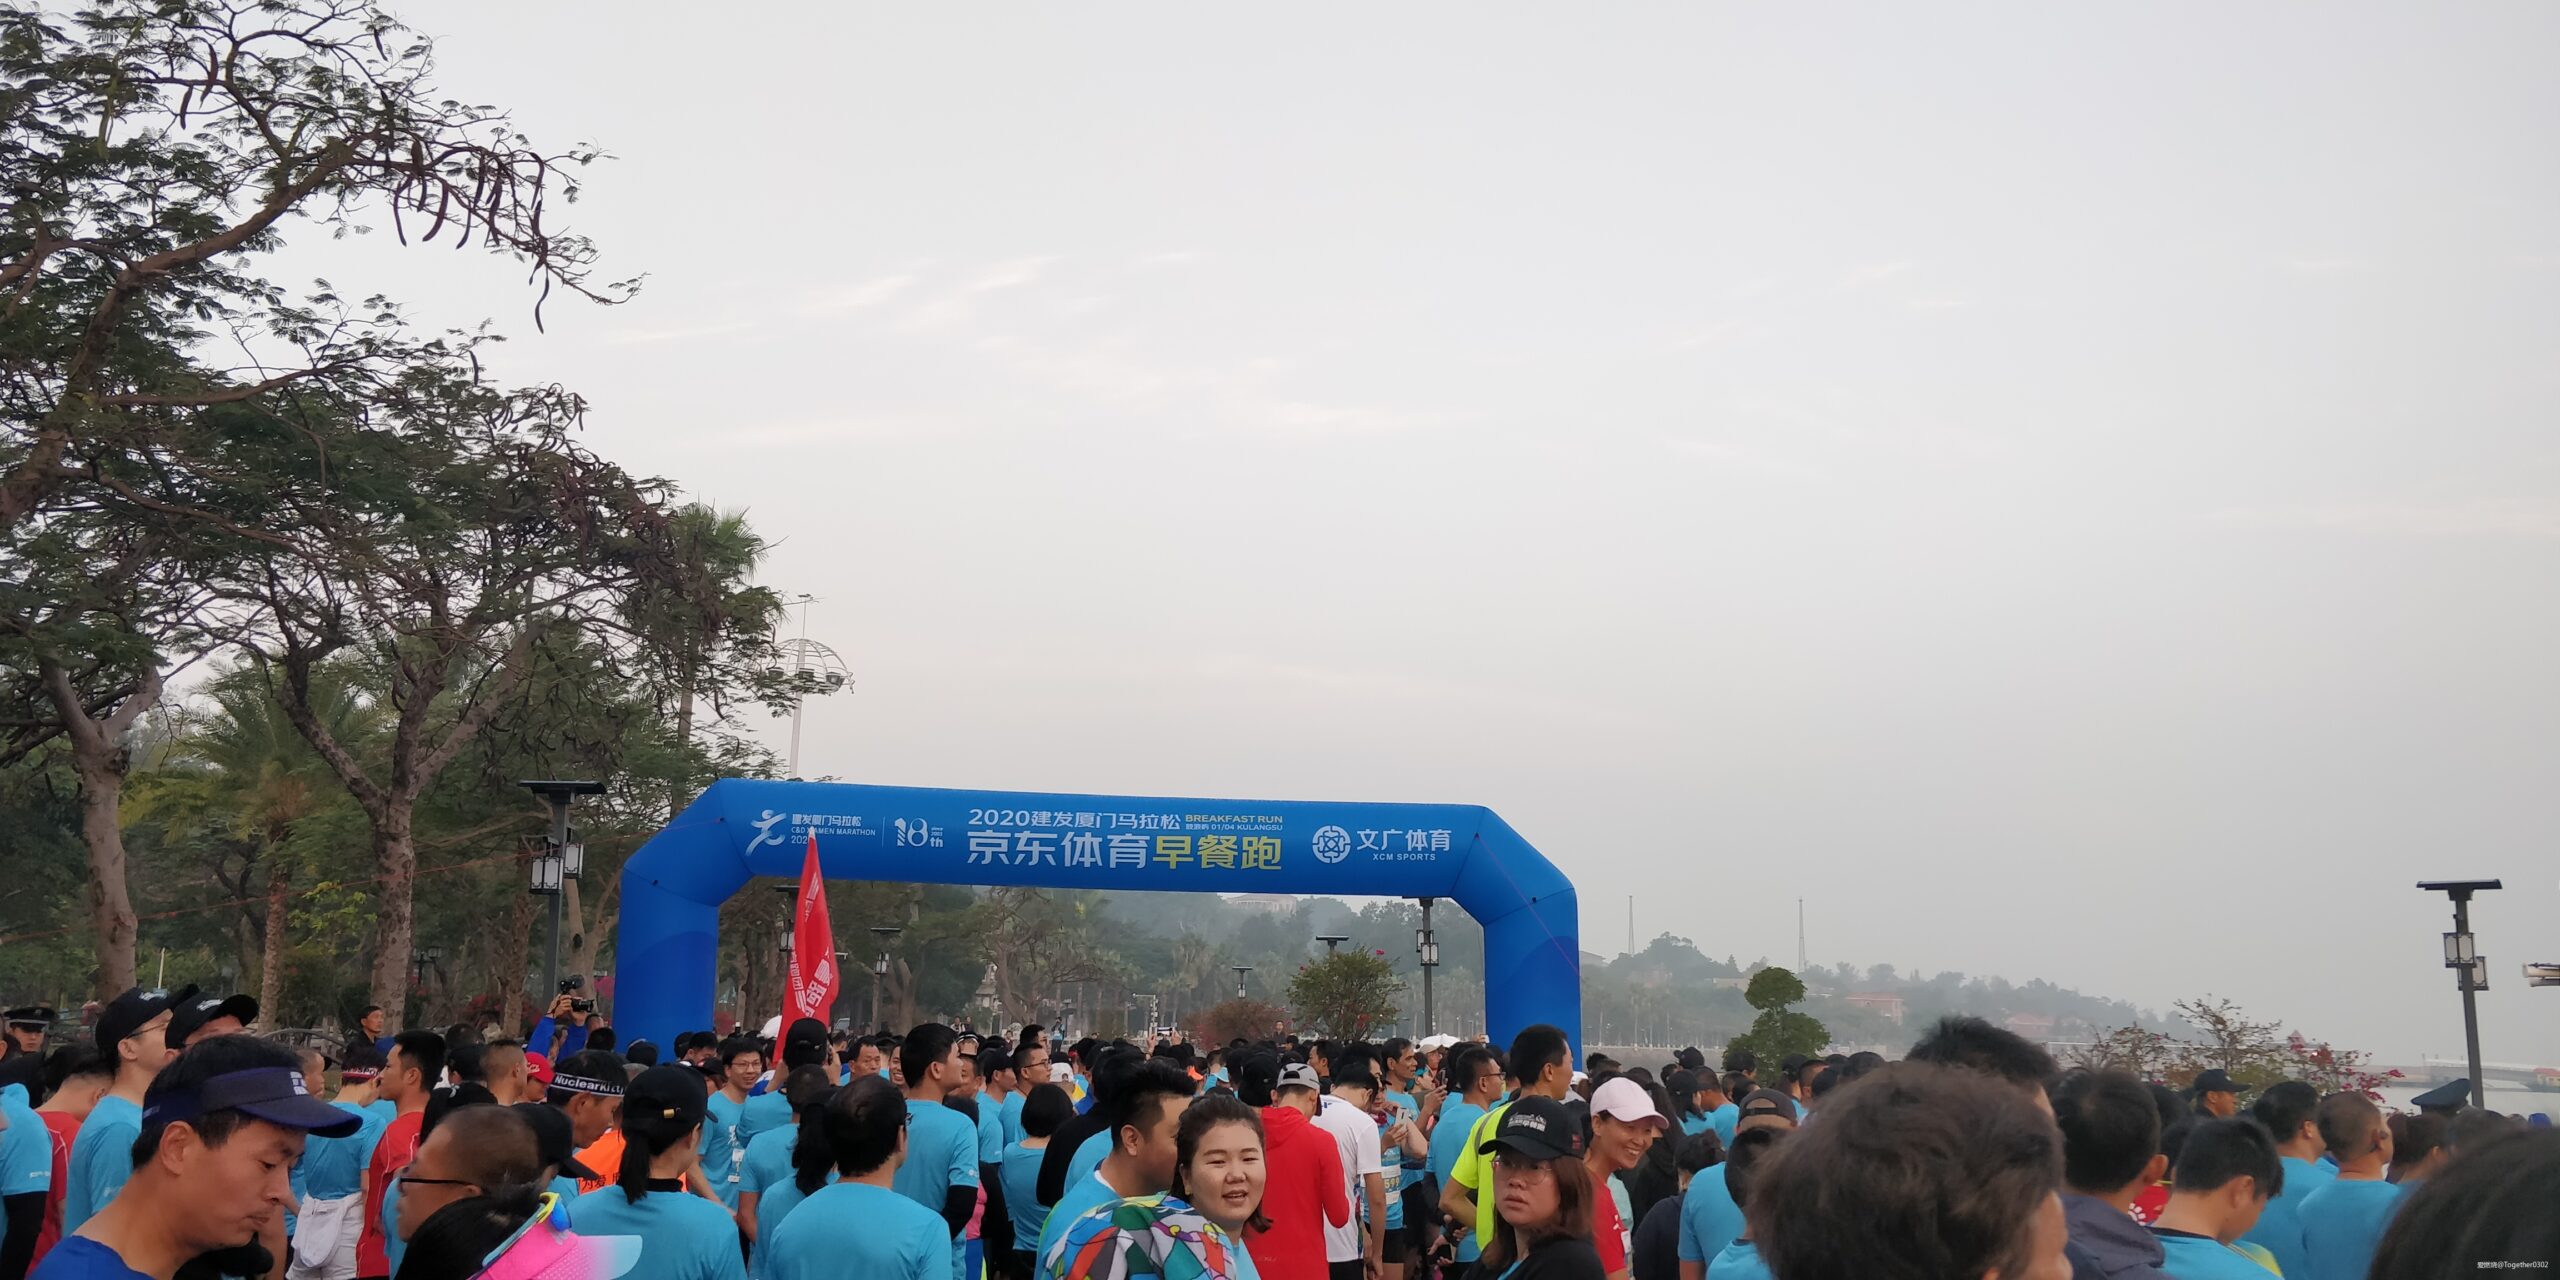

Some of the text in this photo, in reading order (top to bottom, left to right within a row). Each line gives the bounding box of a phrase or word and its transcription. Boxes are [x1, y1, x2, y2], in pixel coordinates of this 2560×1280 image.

[792, 813, 862, 827] 建发厦门马拉松
[968, 809, 1181, 830] 2020建发厦门马拉松
[1185, 814, 1283, 824] BREAKFAST RUN
[791, 826, 806, 834] C&D
[836, 828, 876, 836] MARATHON
[1211, 823, 1235, 831] 01/04
[1237, 823, 1283, 831] KULANGSU
[1356, 828, 1452, 852] 文广体育
[967, 829, 1282, 870] 京东体育早餐跑
[1372, 853, 1436, 861] XCM SPORTS
